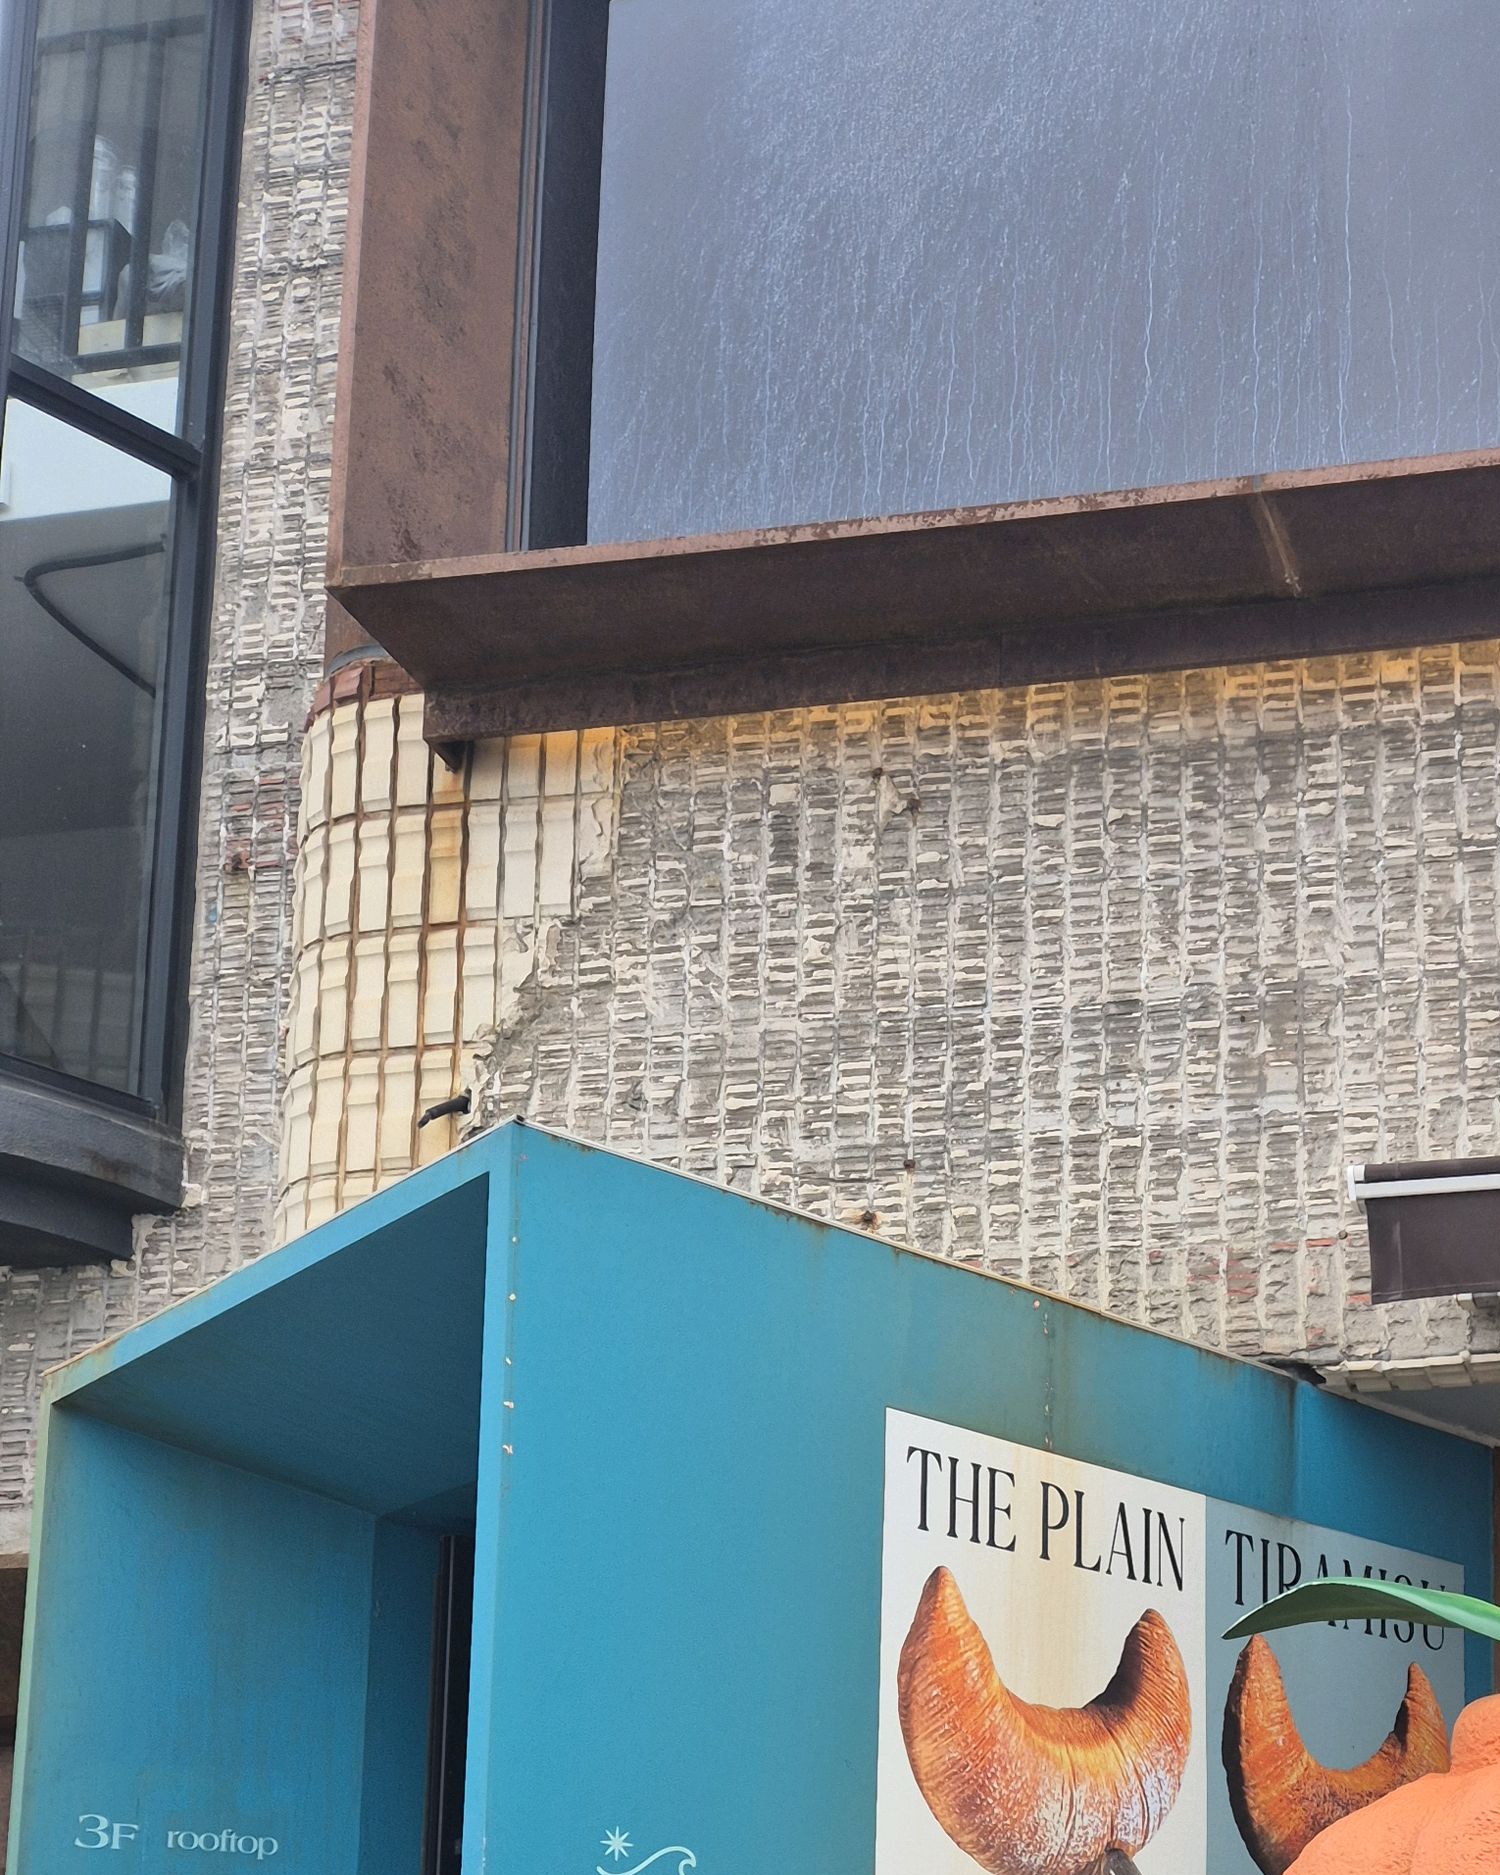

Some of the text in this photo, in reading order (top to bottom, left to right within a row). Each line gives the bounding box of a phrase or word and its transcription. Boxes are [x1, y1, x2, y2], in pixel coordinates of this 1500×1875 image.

[906, 1445, 1186, 1592] THE PLAIN
[74, 1814, 279, 1860] 3F rooftop
